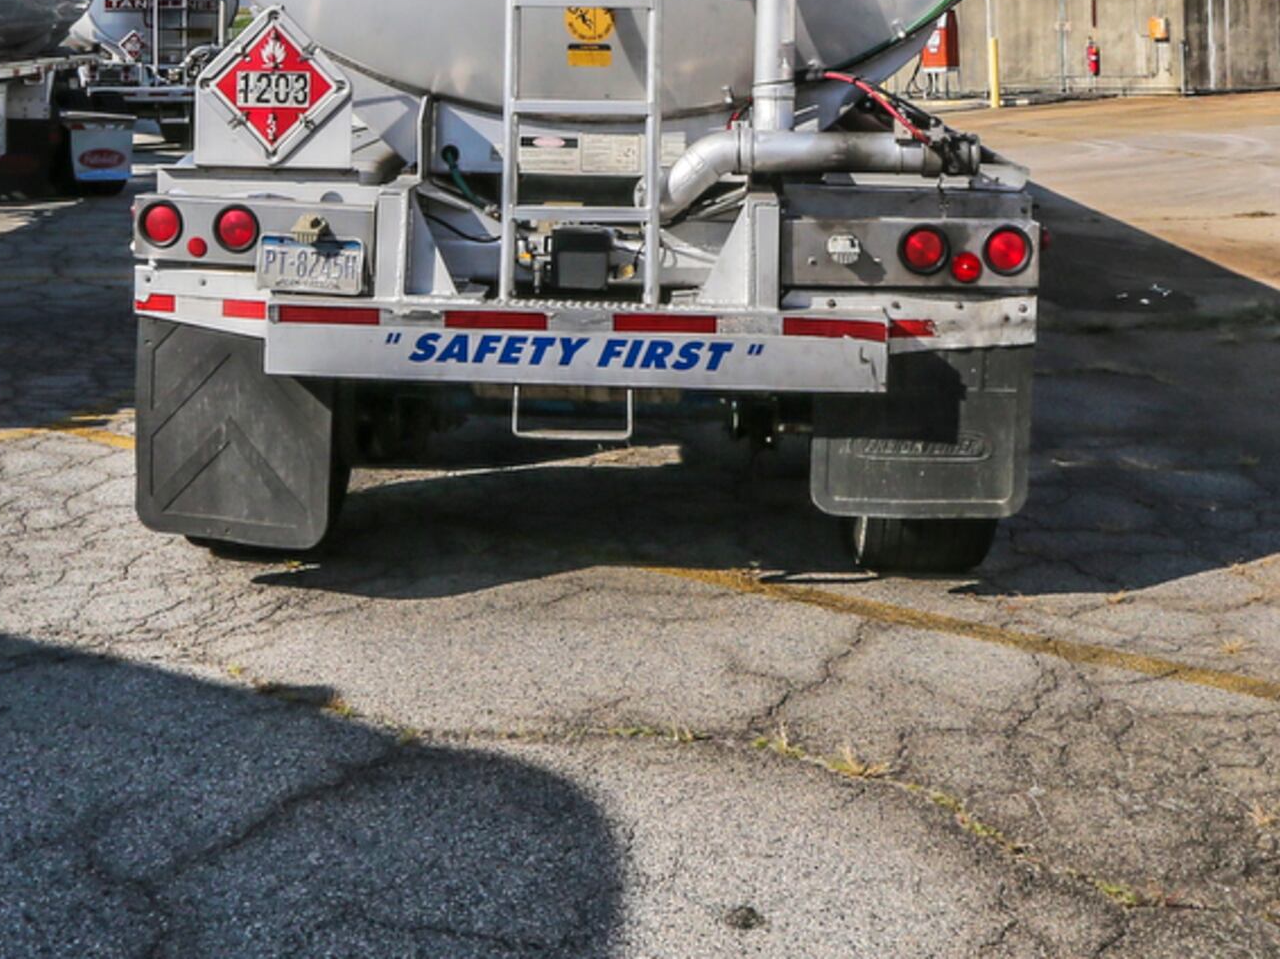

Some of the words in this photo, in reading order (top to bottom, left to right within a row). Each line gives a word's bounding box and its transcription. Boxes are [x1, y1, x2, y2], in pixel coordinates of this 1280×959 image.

[239, 72, 308, 105] 1203
[409, 333, 590, 366] SAFETY
[597, 339, 734, 371] FIRST
